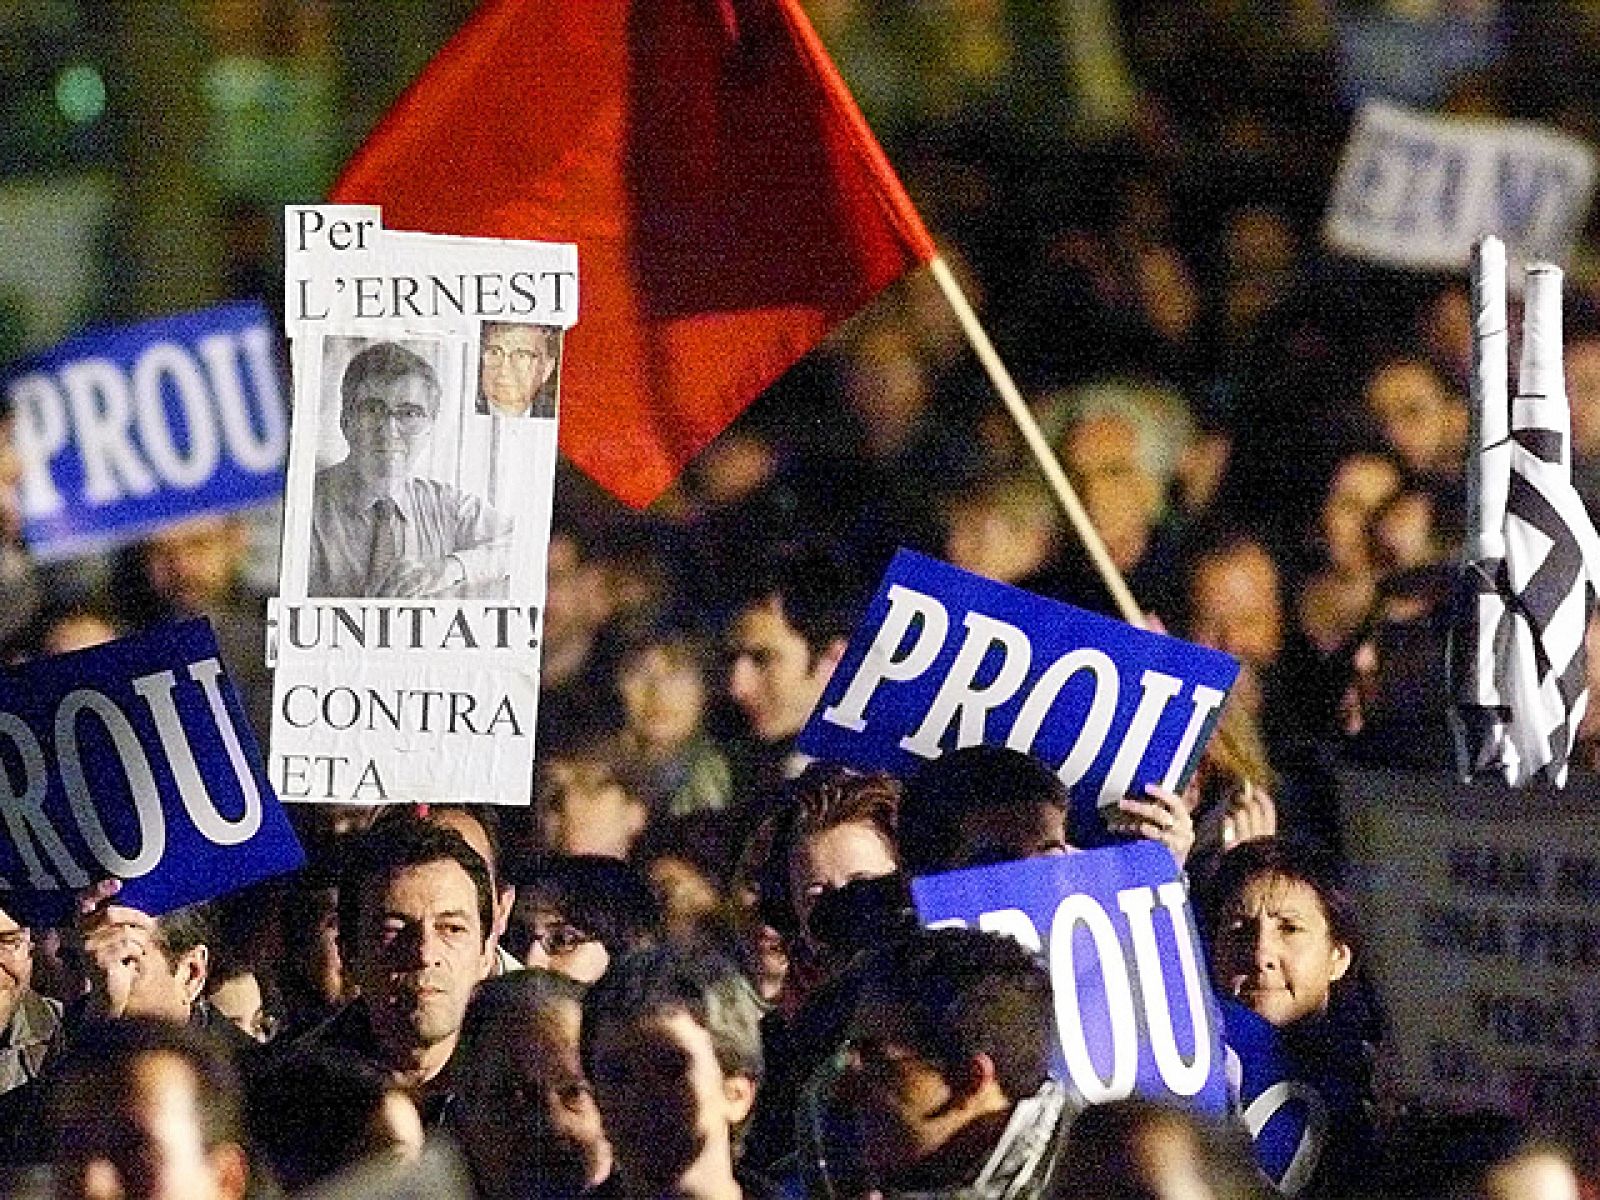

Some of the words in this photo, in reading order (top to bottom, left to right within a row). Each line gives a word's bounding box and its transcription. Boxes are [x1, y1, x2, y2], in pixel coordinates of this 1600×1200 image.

[295, 210, 373, 251] Per
[296, 272, 575, 320] L'ERNEST
[9, 327, 287, 514] PROU
[282, 685, 525, 736] CONTRA
[0, 657, 263, 890] ROU
[279, 755, 388, 799] ETA
[926, 881, 1211, 1104] OU
